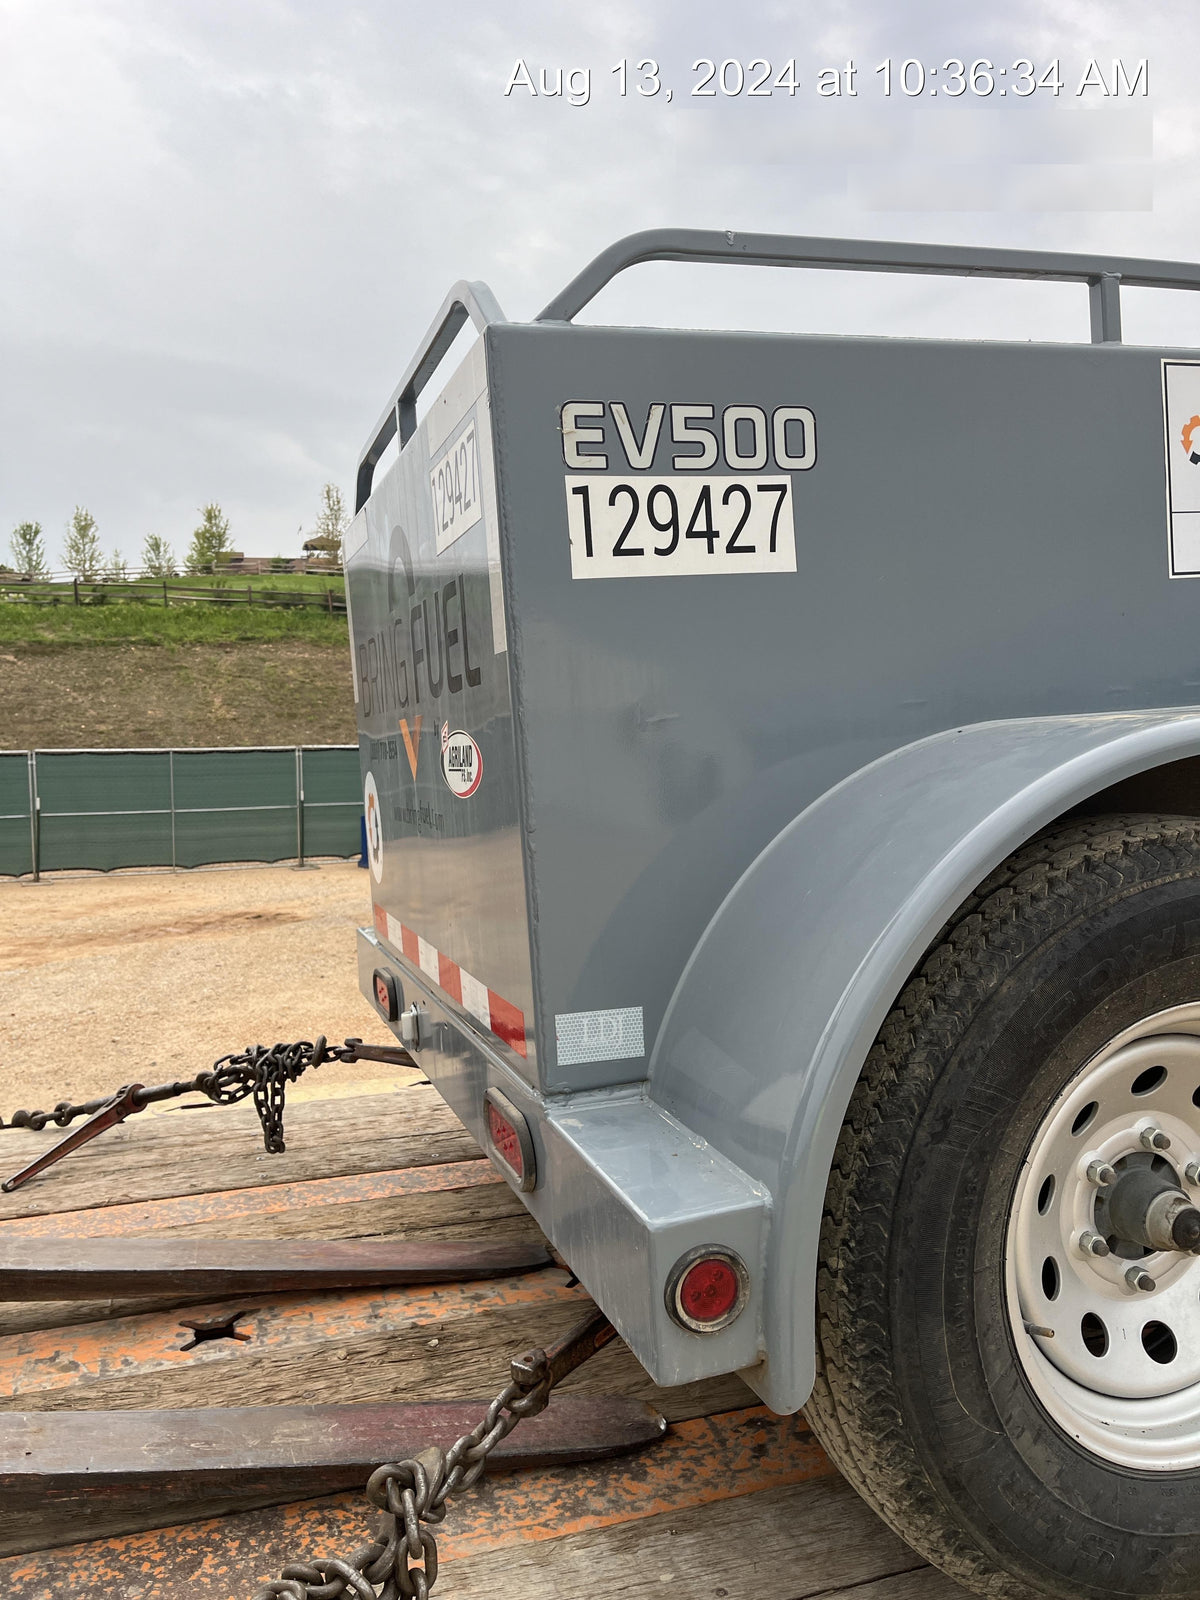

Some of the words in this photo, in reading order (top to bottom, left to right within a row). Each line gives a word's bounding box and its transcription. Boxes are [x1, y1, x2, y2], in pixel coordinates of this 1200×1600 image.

[560, 400, 818, 471] EV500
[432, 429, 476, 537] 129427
[571, 484, 788, 558] 129427
